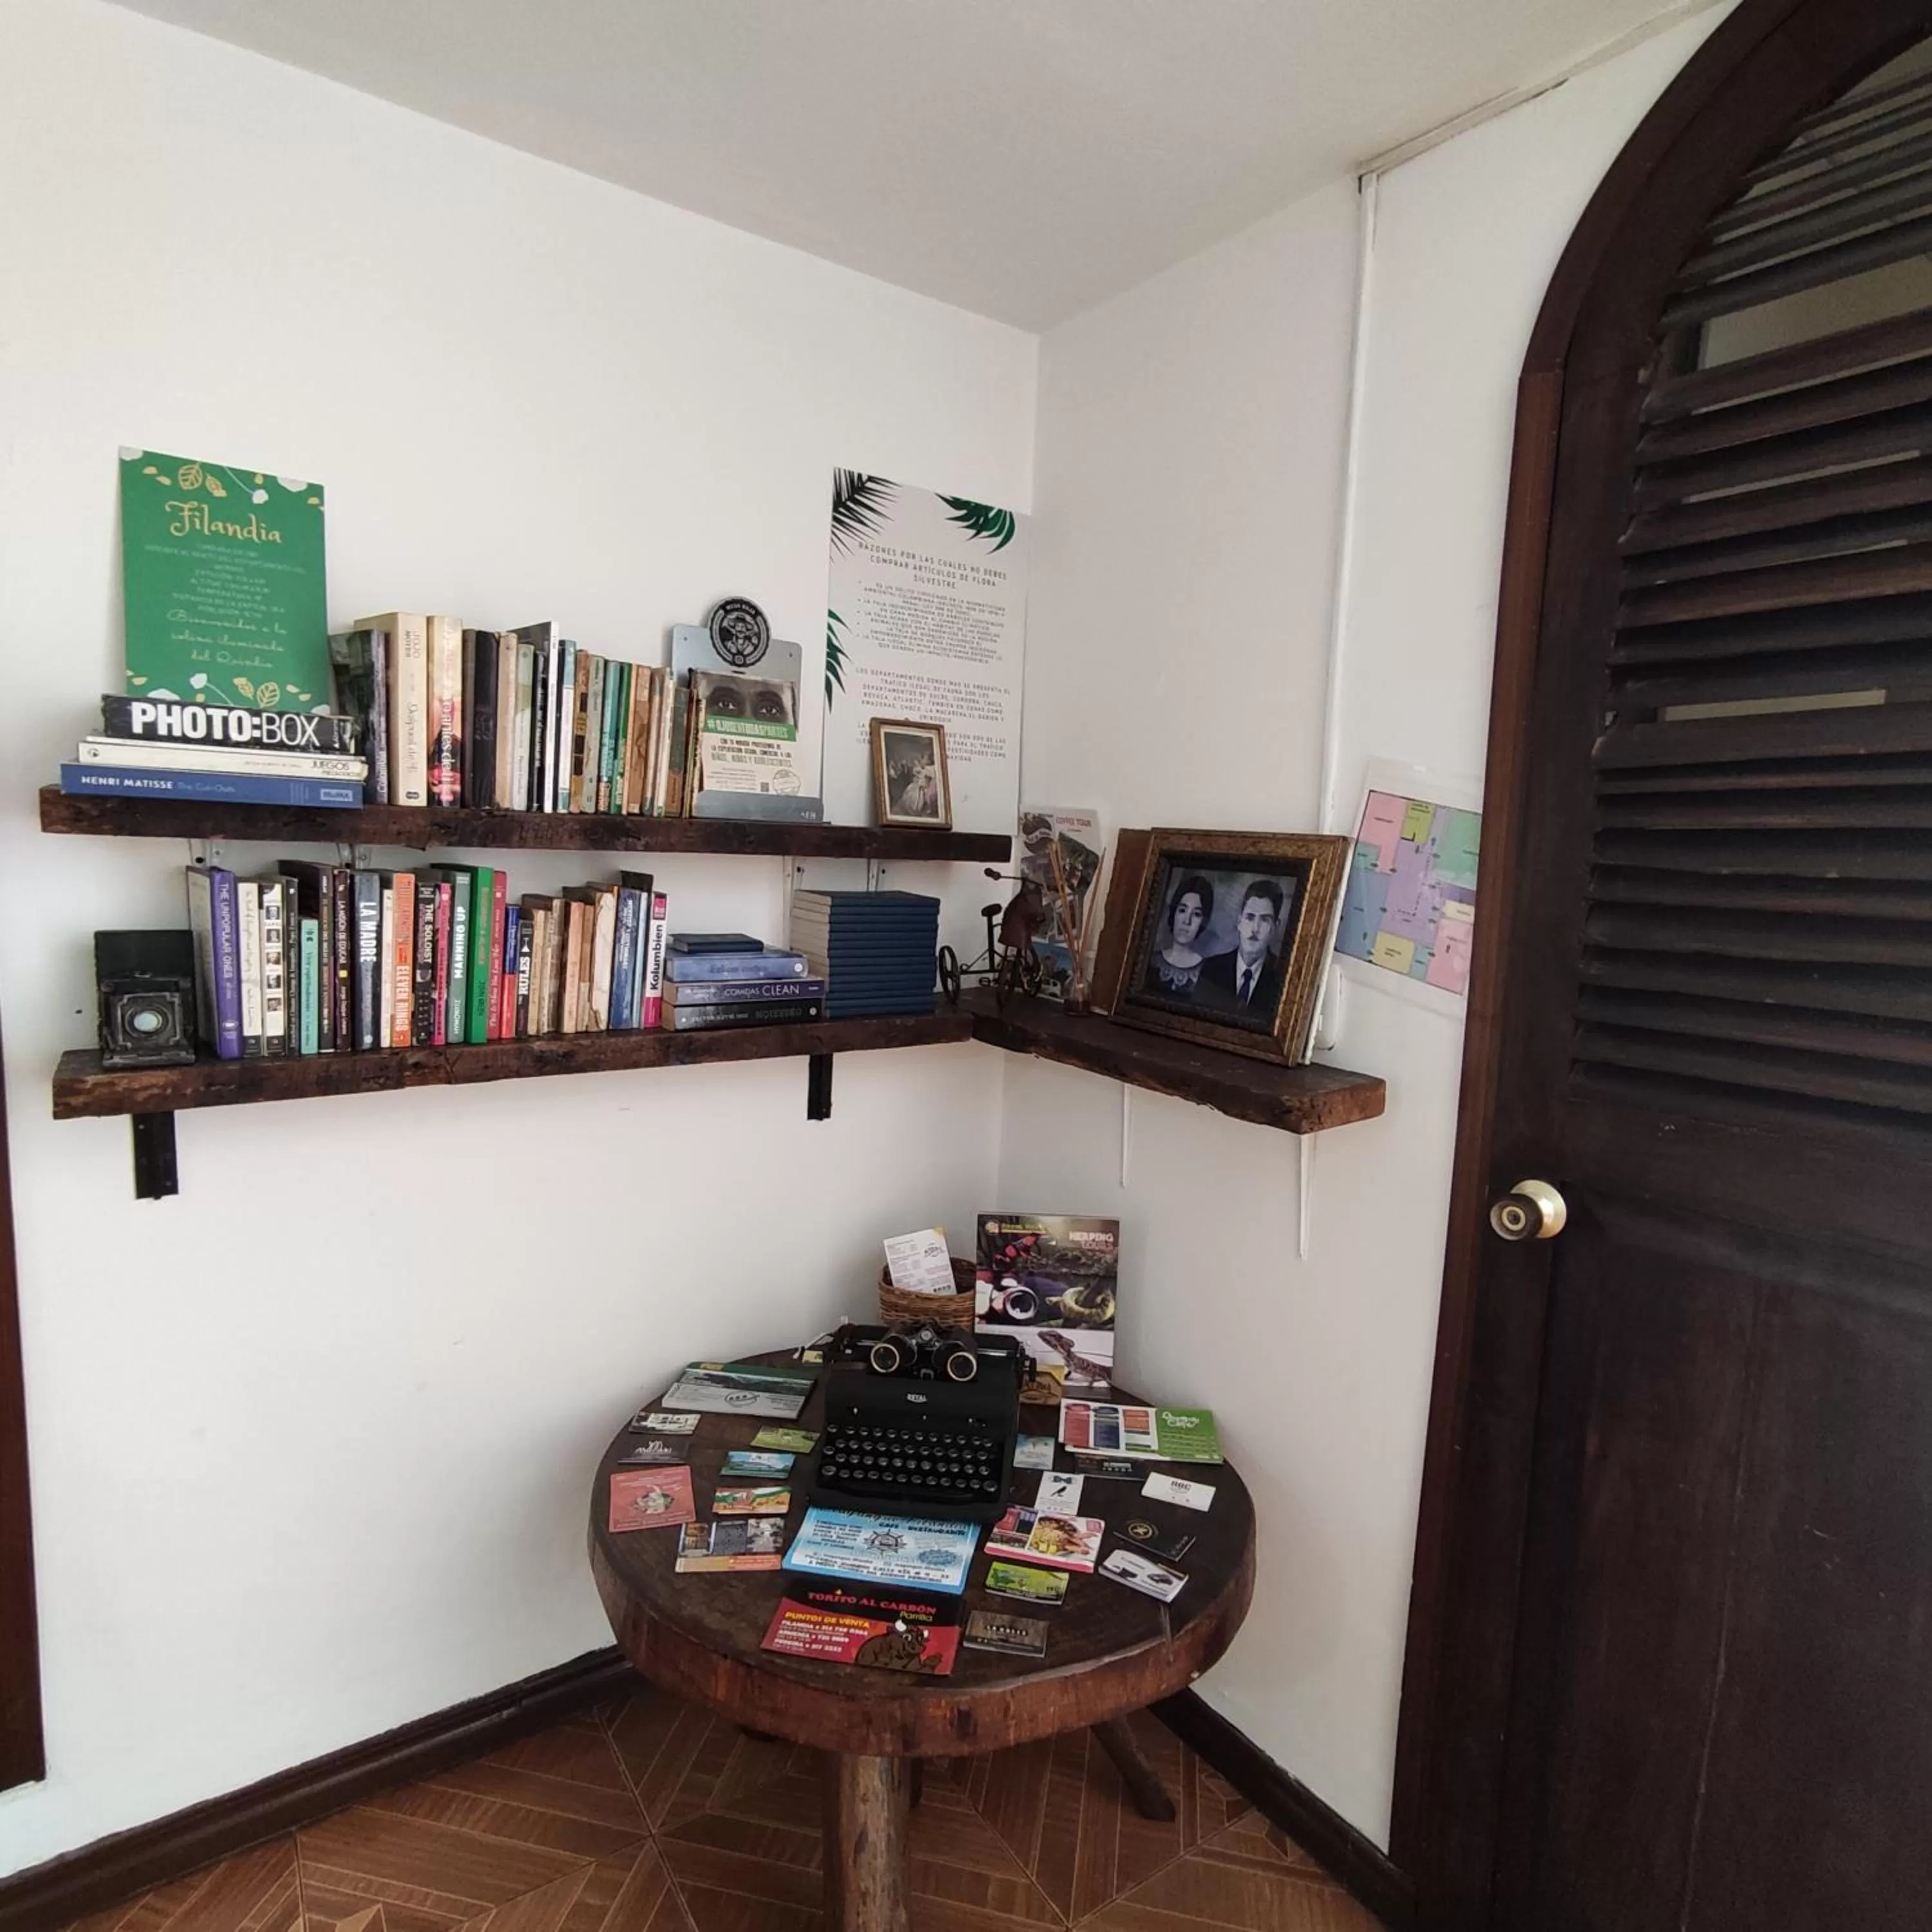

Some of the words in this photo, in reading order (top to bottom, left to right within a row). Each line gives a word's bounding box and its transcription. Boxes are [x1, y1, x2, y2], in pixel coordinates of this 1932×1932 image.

[165, 500, 282, 543] Filandia
[920, 553, 934, 564] LAS
[938, 556, 967, 572] CUALES
[131, 701, 321, 747] PHOTO:BOX
[441, 714, 453, 750] antes
[441, 752, 455, 768] de
[82, 776, 120, 786] HENRI
[124, 778, 173, 789] MATISSE
[220, 882, 230, 900] THE
[359, 902, 376, 916] LA
[424, 904, 433, 923] THE
[455, 906, 467, 923] UP
[221, 901, 232, 953] UNPOPULAR
[359, 921, 377, 963] MADRE
[422, 925, 433, 964] SOLOIST
[453, 925, 466, 979] MANNING
[223, 955, 232, 979] ONES
[650, 923, 663, 990] Kolumbien
[395, 965, 410, 1005] ELEVEN
[519, 956, 531, 995] RULES
[724, 987, 760, 997] COMIDAS
[762, 984, 800, 996] CLEAN
[395, 1007, 410, 1032] RINGS
[808, 1592, 857, 1604] TORITO
[785, 1611, 822, 1622] PUNTOS
[838, 1618, 869, 1629] VENTA
